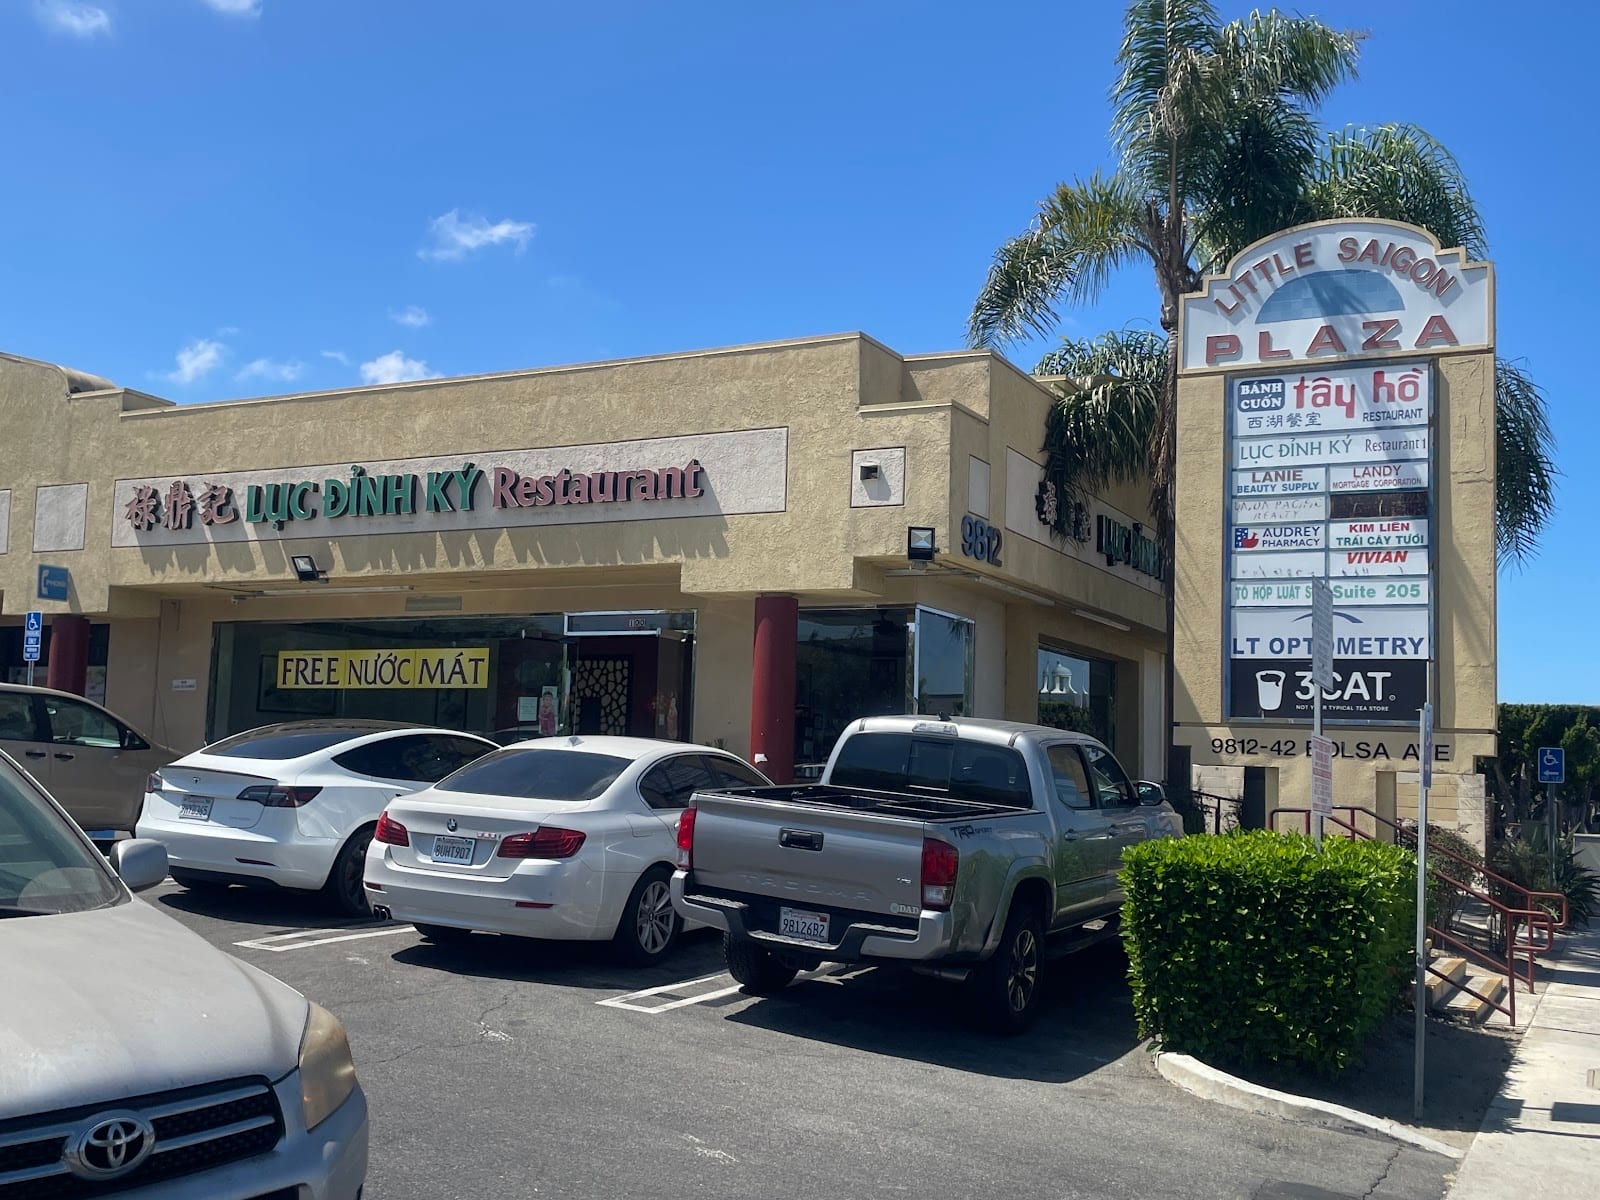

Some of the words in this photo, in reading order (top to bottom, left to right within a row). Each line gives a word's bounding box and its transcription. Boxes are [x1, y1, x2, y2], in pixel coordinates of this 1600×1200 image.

[1214, 242, 1316, 316] LITTLE
[1337, 237, 1457, 298] SAIGON
[1205, 314, 1458, 364] PLAZA
[1240, 381, 1283, 396] BÁNH
[1293, 375, 1355, 419] tây
[1362, 407, 1424, 423] RESTAURANT
[1240, 444, 1274, 464] LỤC
[1365, 438, 1421, 453] Restaurant
[1251, 470, 1304, 484] LANIE
[1353, 465, 1402, 478] LANDY
[1237, 484, 1277, 494] BEAUTY
[1281, 481, 1320, 492] SUPPLY
[1332, 480, 1370, 490] MORTGAGE
[1373, 477, 1422, 488] CORPORATION
[246, 480, 320, 531] LỤC
[322, 464, 416, 518] ĐỈNH
[425, 462, 484, 512] KÝ
[492, 459, 702, 509] Restaurant
[1263, 527, 1320, 537] AUDREY
[1349, 524, 1375, 533] KIM
[961, 515, 1003, 567] 9812
[1262, 538, 1320, 547] PHARMACY
[1347, 550, 1408, 564] VIVIAN
[1333, 586, 1376, 598] Suite
[1386, 584, 1421, 598] 205
[1233, 637, 1260, 655] LT
[1269, 637, 1424, 655] OPTMETRY
[282, 657, 339, 685] FREE
[348, 652, 411, 686] NƯỚC
[418, 652, 485, 685] MÁT
[1211, 738, 1296, 756] 9812-42
[1403, 743, 1450, 761] AE
[950, 825, 974, 840] TRD
[900, 905, 920, 914] DAD
[783, 919, 825, 938] 98126B2
